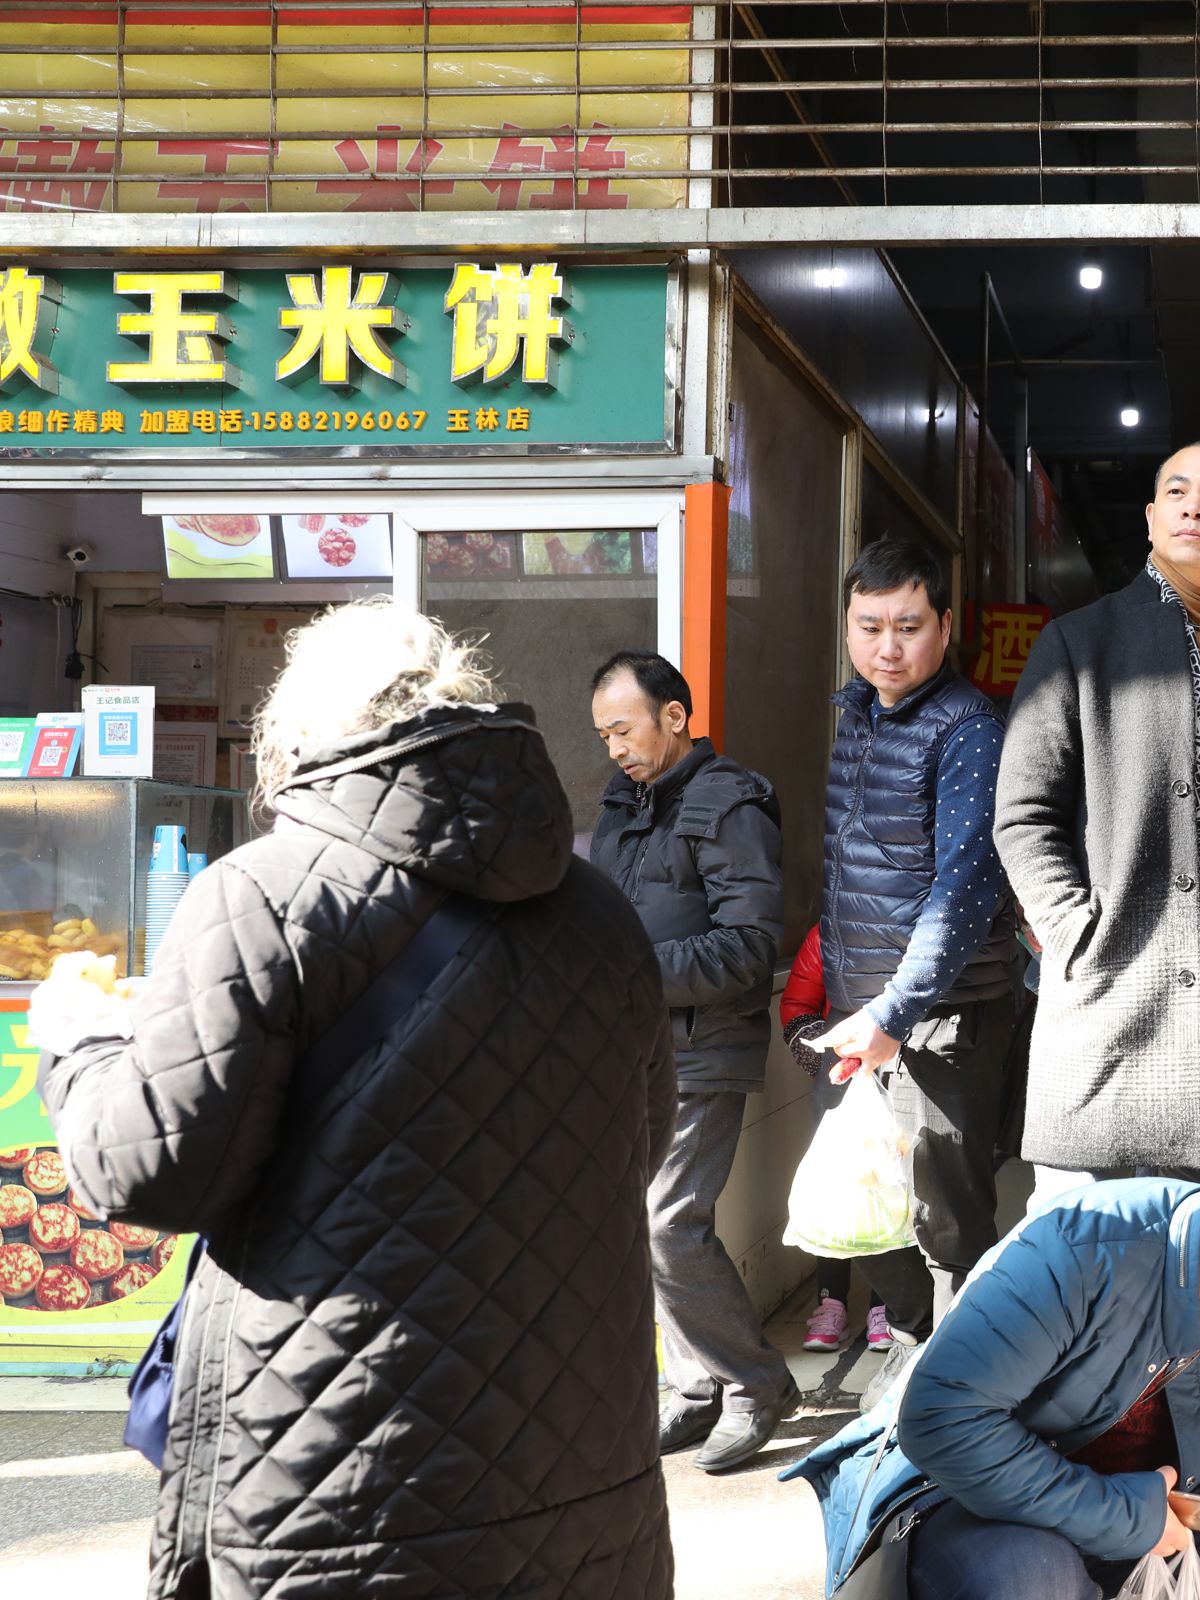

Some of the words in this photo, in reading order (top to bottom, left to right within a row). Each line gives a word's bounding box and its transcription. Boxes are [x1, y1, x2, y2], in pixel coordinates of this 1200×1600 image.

[446, 407, 530, 432] 玉林店
[973, 609, 1043, 684] 酒
[96, 696, 140, 705] 王记食品店
